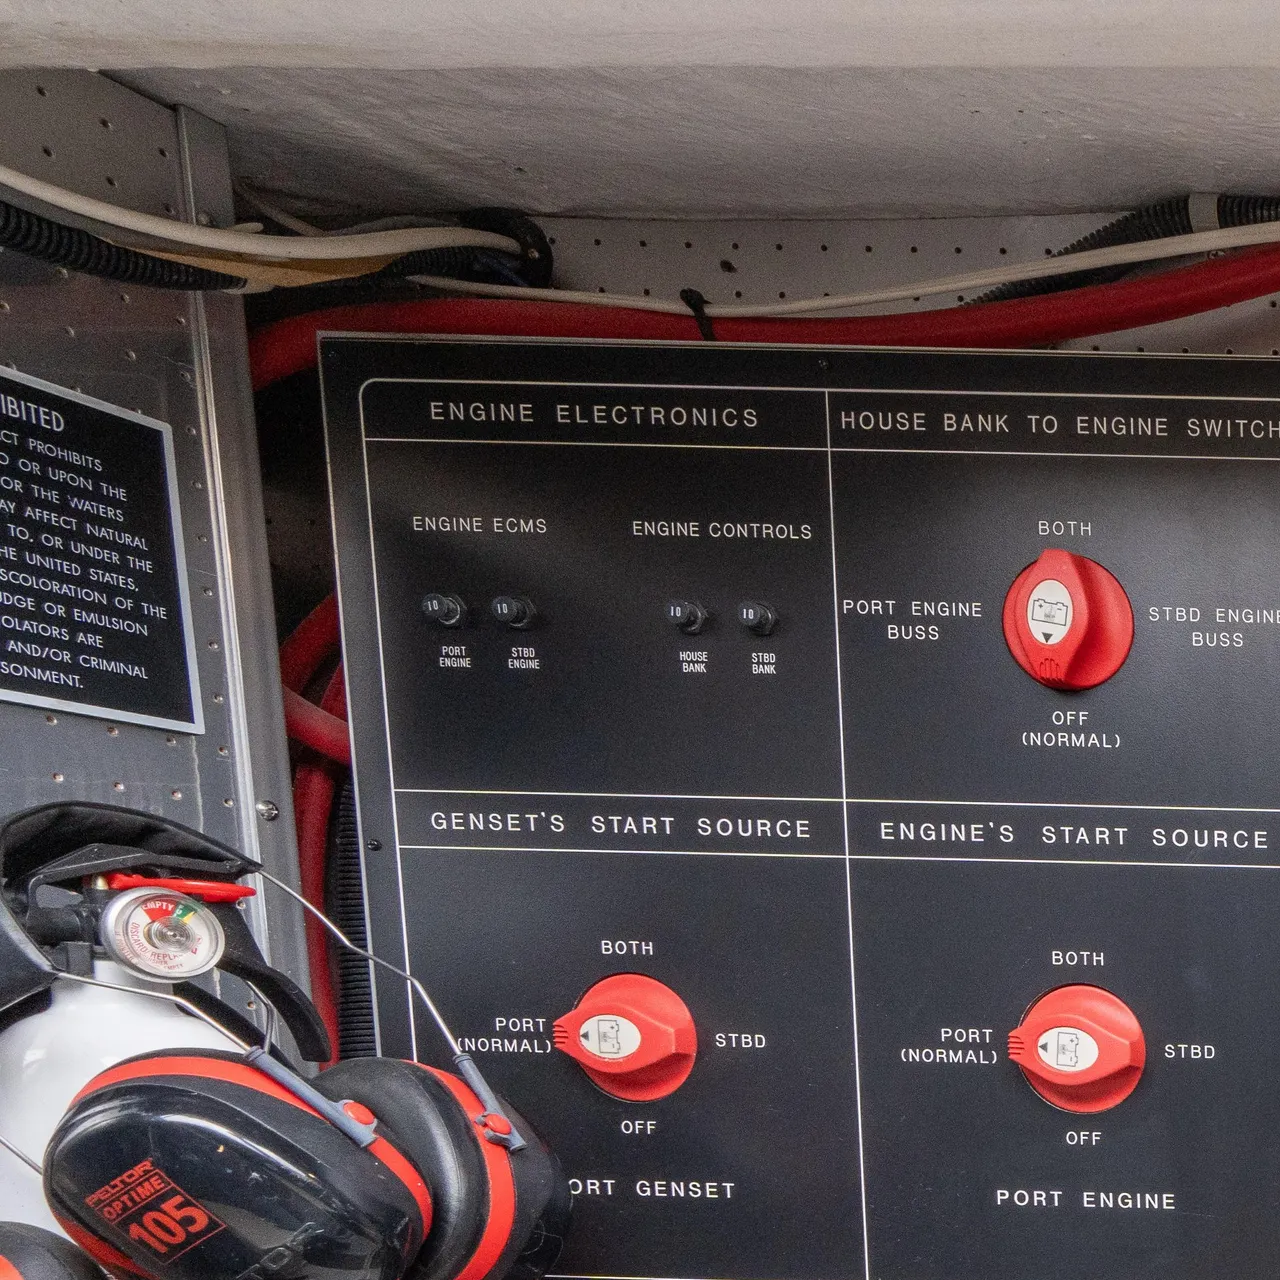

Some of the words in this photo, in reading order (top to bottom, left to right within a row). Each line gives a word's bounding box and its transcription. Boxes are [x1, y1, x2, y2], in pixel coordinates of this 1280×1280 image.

[430, 401, 534, 422] ENGINE
[556, 404, 758, 428] ELECTRONICS
[841, 411, 926, 431] HOUSE
[943, 413, 1009, 433] BANK
[1027, 415, 1058, 434] TO
[1076, 416, 1168, 436] ENGINE
[29, 438, 103, 472] PROHIBITS
[19, 459, 41, 475] OR
[48, 467, 93, 491] UPON
[100, 482, 127, 501] THE
[31, 484, 60, 504] THE
[67, 495, 124, 522] WATERS
[24, 506, 77, 531] AFFECT
[87, 523, 148, 551] NATURAL
[412, 516, 483, 533] ENGINE
[493, 517, 547, 534] ECMS
[632, 520, 700, 537] ENGINE
[708, 522, 812, 540] CONTROLS
[1038, 520, 1092, 537] BOTH
[41, 534, 63, 550] OR
[70, 541, 120, 565] UNDER
[127, 556, 153, 573] THE
[25, 551, 81, 576] UNITED
[115, 597, 134, 611] OF
[141, 602, 167, 620] THE
[842, 599, 896, 615] PORT
[911, 601, 982, 618] ENGINE
[1148, 606, 1201, 623] STBD
[44, 602, 66, 618] OR
[73, 608, 148, 637] EMULSION
[77, 632, 104, 648] ARE
[887, 624, 939, 641] BUSS
[1191, 631, 1244, 648] BUSS
[7, 640, 72, 664] AND/OR
[79, 655, 148, 679] CRIMINAL
[442, 646, 466, 656] PORT
[511, 647, 535, 657] STBD
[680, 651, 708, 661] HOUSE
[751, 653, 776, 663] STBD
[440, 657, 471, 667] ENGINE
[508, 659, 540, 669] ENGINE
[683, 663, 707, 673] BANK
[752, 664, 776, 674] BANK
[1051, 710, 1089, 726] OFF
[1022, 731, 1121, 748] (NORMAL)
[430, 811, 565, 833] GENSET'S
[591, 815, 675, 835] START
[697, 817, 810, 838] SOURCE
[880, 821, 1014, 843] ENGINE'S
[1042, 825, 1128, 845] START
[1152, 828, 1268, 849] SOURCE
[600, 939, 654, 956] BOTH
[1051, 950, 1105, 966] BOTH
[495, 1017, 546, 1033] PORT
[715, 1032, 766, 1049] STBD
[940, 1027, 993, 1044] PORT
[457, 1037, 552, 1054] (NORMAL)
[1164, 1043, 1216, 1059] STBD
[900, 1048, 998, 1064] (NORMAL)
[620, 1120, 657, 1135] OFF
[1065, 1130, 1102, 1146] OFF
[85, 1158, 156, 1208] PELTOR
[568, 1179, 616, 1195] ORT
[635, 1181, 735, 1199] GENSET
[103, 1176, 167, 1219] OPTIME
[996, 1189, 1063, 1207] PORT
[1082, 1191, 1176, 1210] ENGINE
[129, 1198, 210, 1255] 105
